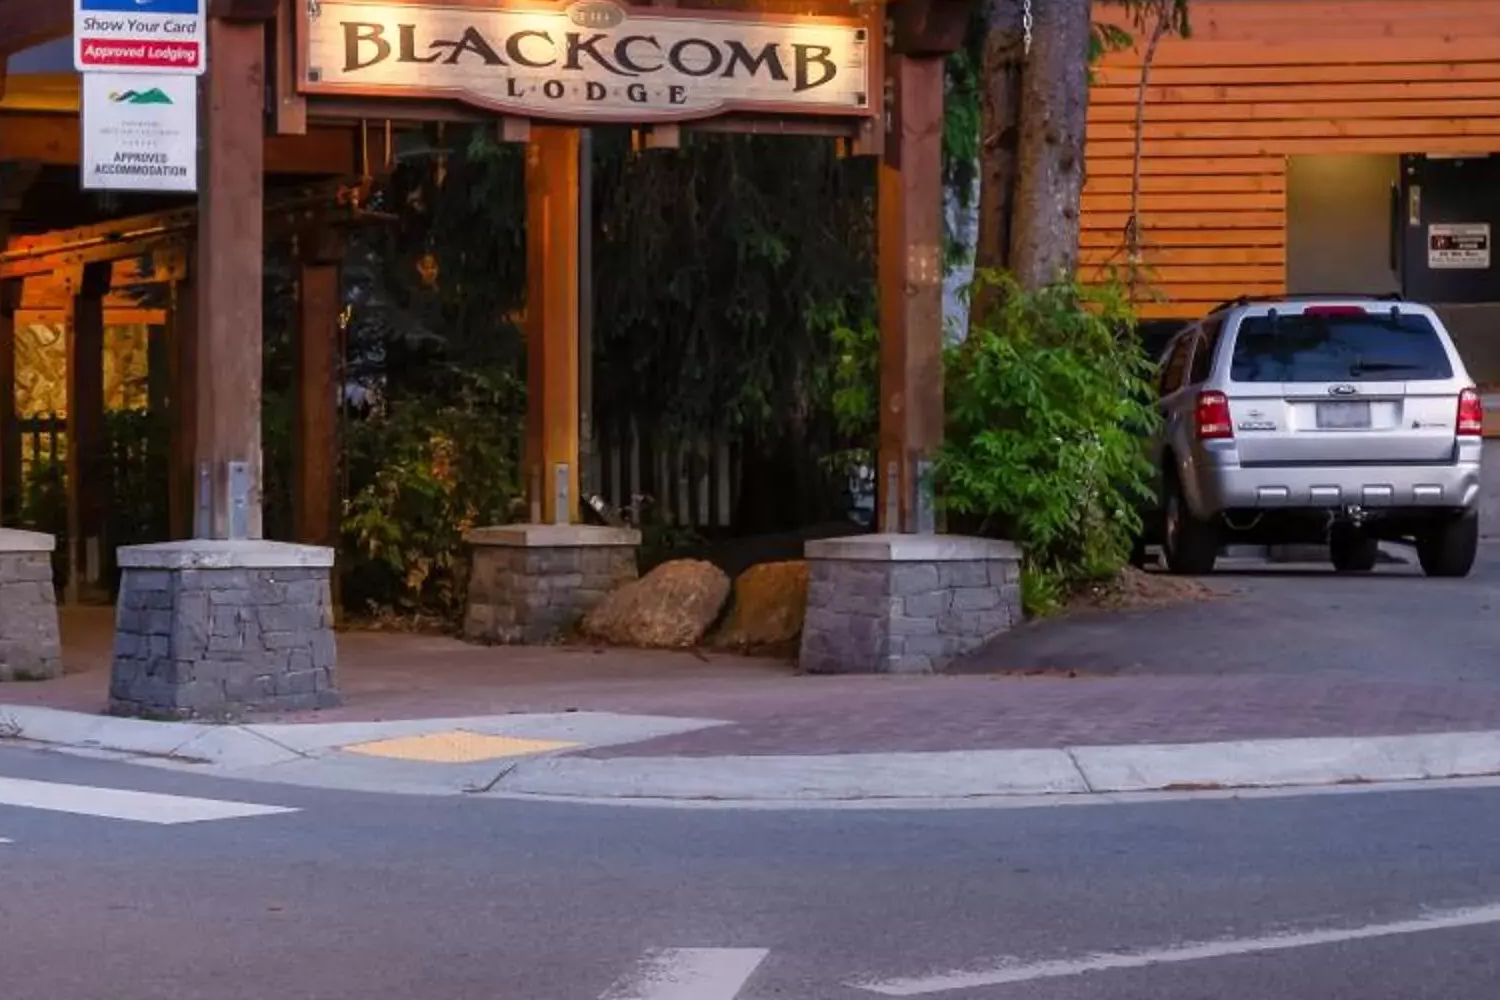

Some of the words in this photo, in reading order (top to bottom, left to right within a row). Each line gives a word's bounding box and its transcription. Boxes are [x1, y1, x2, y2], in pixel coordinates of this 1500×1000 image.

[83, 16, 124, 32] Show
[127, 18, 160, 33] Your
[163, 19, 197, 33] Card
[84, 43, 146, 60] Approved
[147, 44, 196, 63] Lodging
[338, 20, 838, 92] BLACKCOMB
[113, 151, 169, 163] APPROVED
[94, 163, 187, 177] ACCOMMODATION
